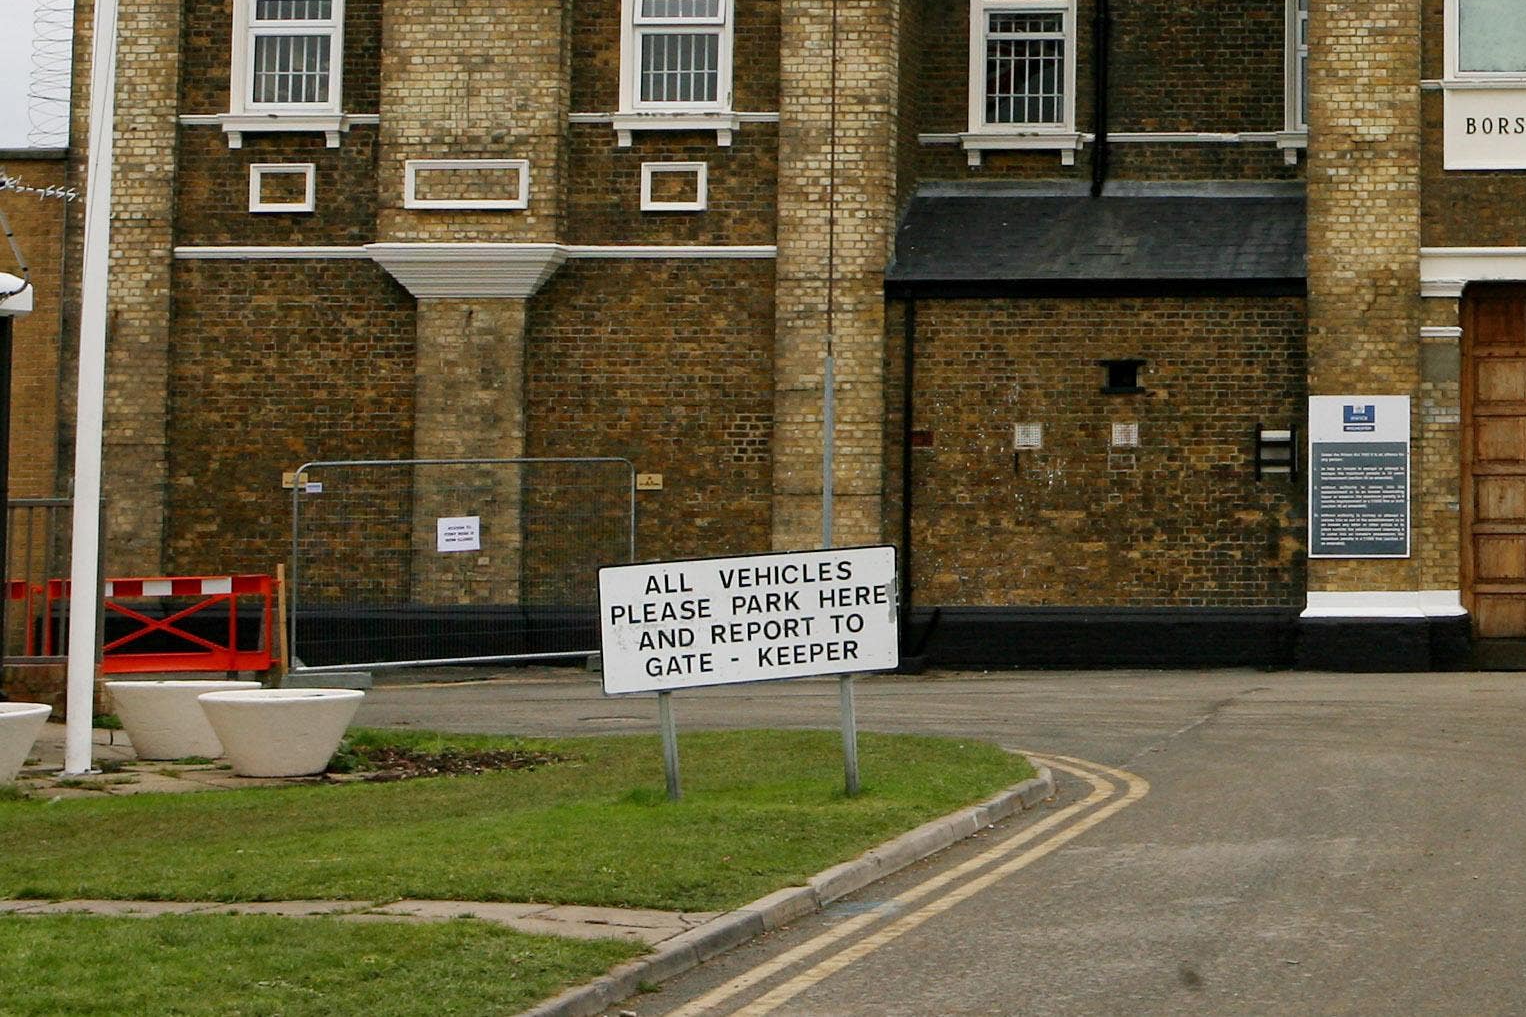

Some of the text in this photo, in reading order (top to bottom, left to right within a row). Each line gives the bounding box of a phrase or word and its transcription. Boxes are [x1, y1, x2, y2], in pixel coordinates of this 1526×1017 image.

[645, 560, 852, 596] ALL VEHICLES
[610, 584, 887, 626] PLEASE PARK HERE
[638, 613, 864, 652] AND REPORT TO
[645, 652, 714, 678] GATE
[758, 640, 858, 668] KEEPER
